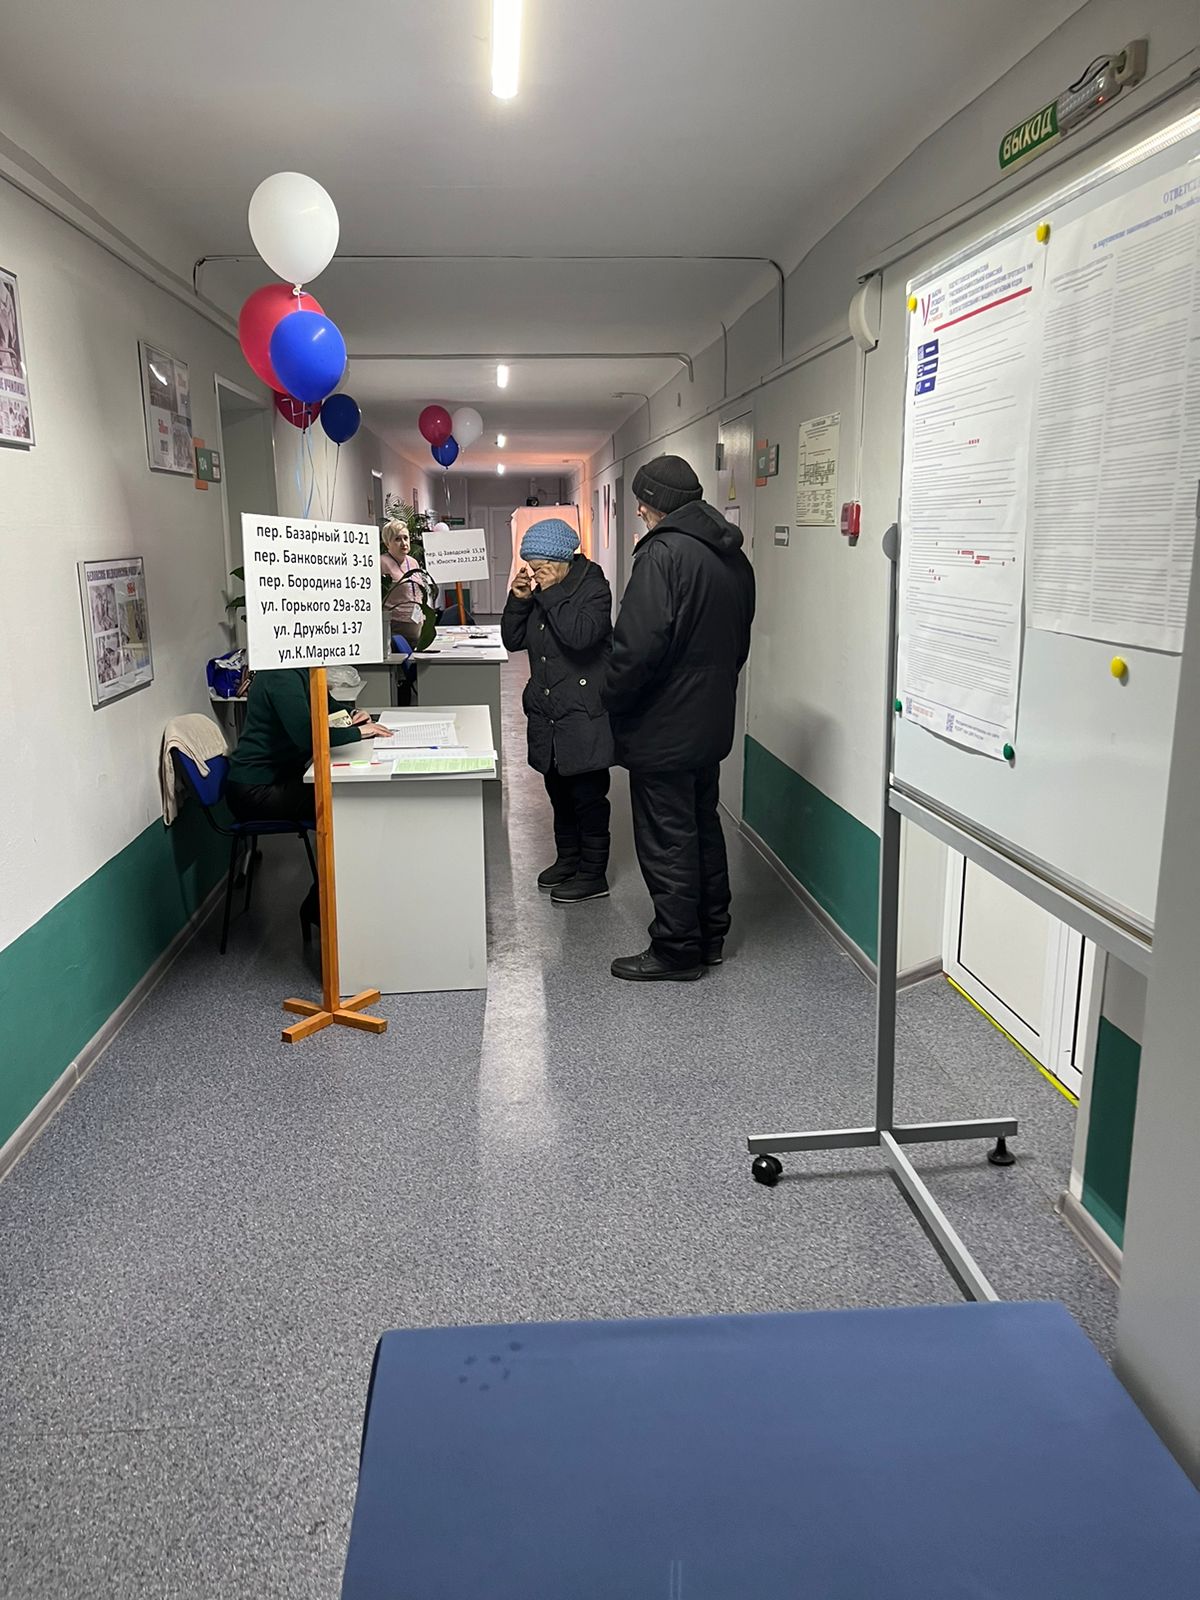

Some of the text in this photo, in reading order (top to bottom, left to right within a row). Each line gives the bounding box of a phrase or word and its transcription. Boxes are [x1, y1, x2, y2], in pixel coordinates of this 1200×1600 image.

[1002, 106, 1053, 161] ВЫХОД
[256, 525, 370, 545] пер. Базарный 10-21
[254, 549, 374, 567] пер. Банковский 3-16
[259, 574, 372, 591] пер. Бородина 16-29
[261, 598, 372, 615] ул. Горького 29а-82а
[273, 621, 363, 639] ул. Дружбы 1-37
[278, 643, 361, 663] ул.К.Маркса 12
